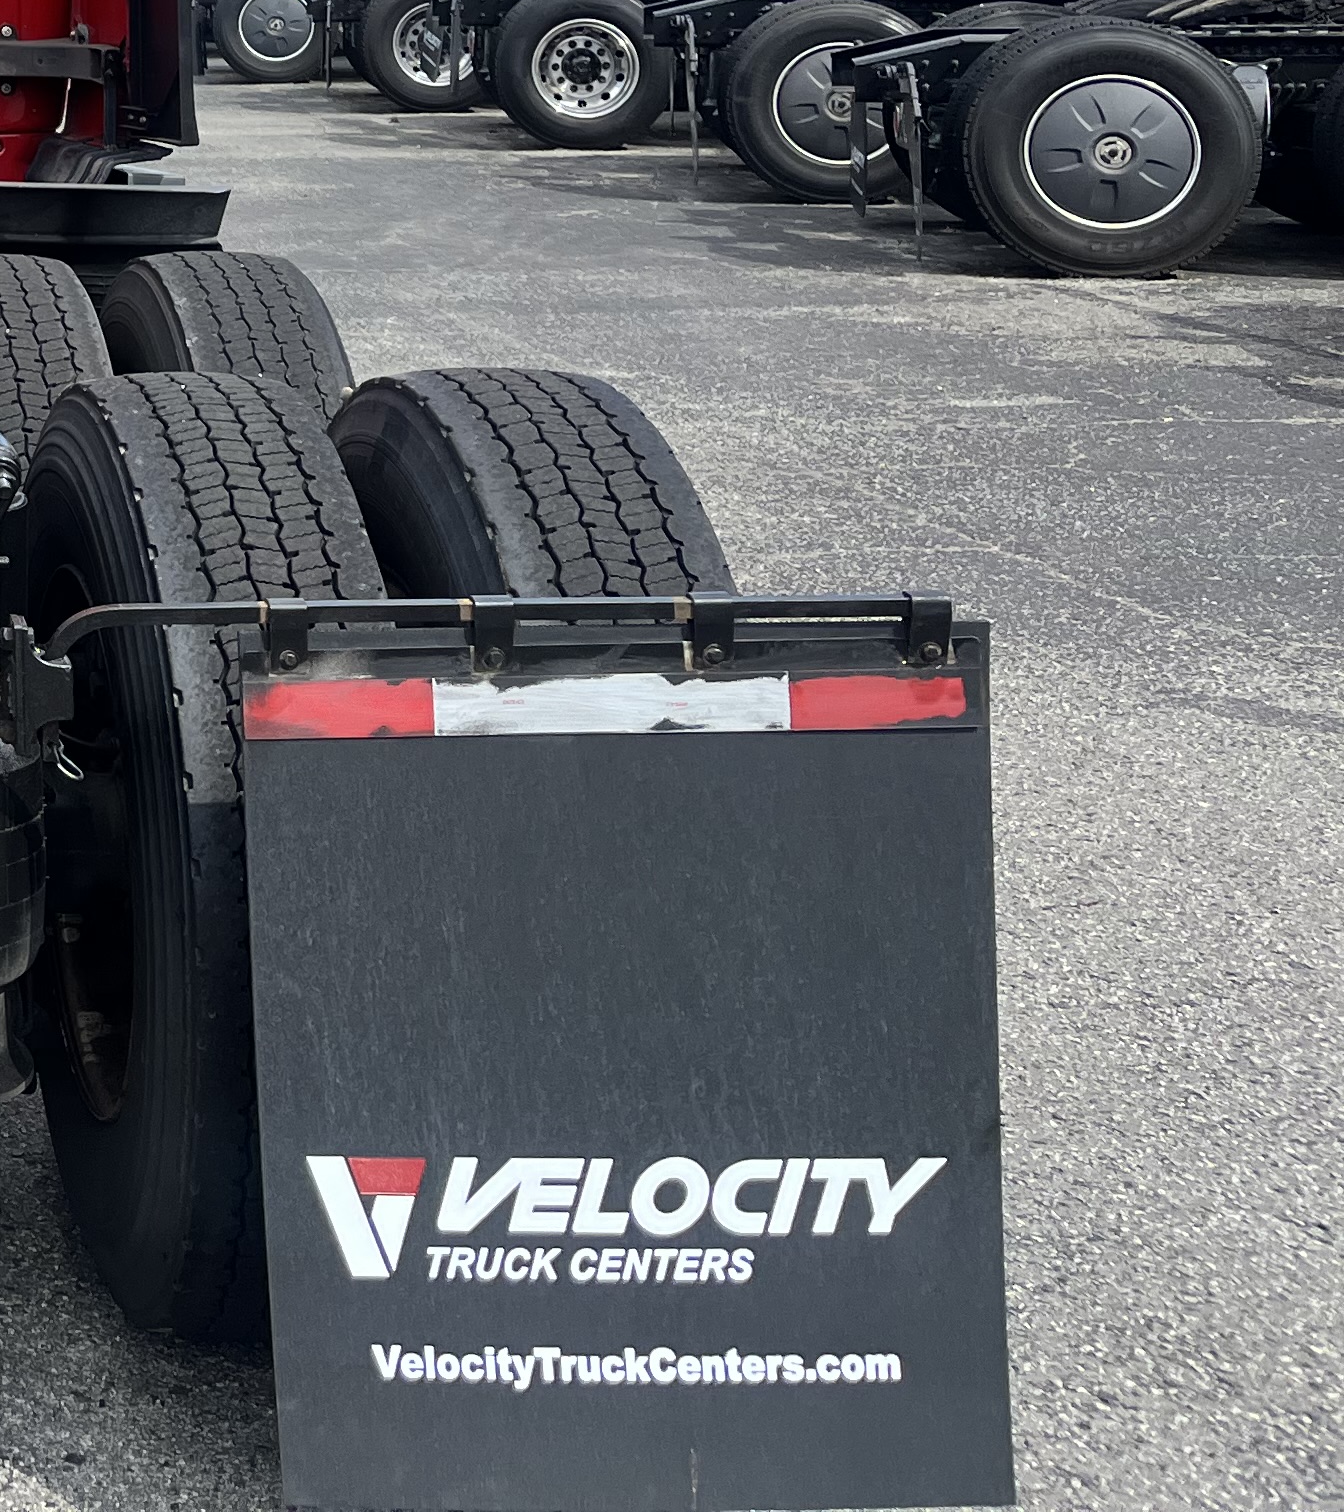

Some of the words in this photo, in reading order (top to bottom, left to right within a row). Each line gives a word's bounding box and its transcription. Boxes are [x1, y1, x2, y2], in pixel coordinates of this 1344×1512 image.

[435, 1156, 948, 1236] VELOCITY
[426, 1246, 560, 1282] TRUCK
[570, 1246, 755, 1284] CENTERS
[371, 1344, 903, 1392] VelocityTruckCenters.com
